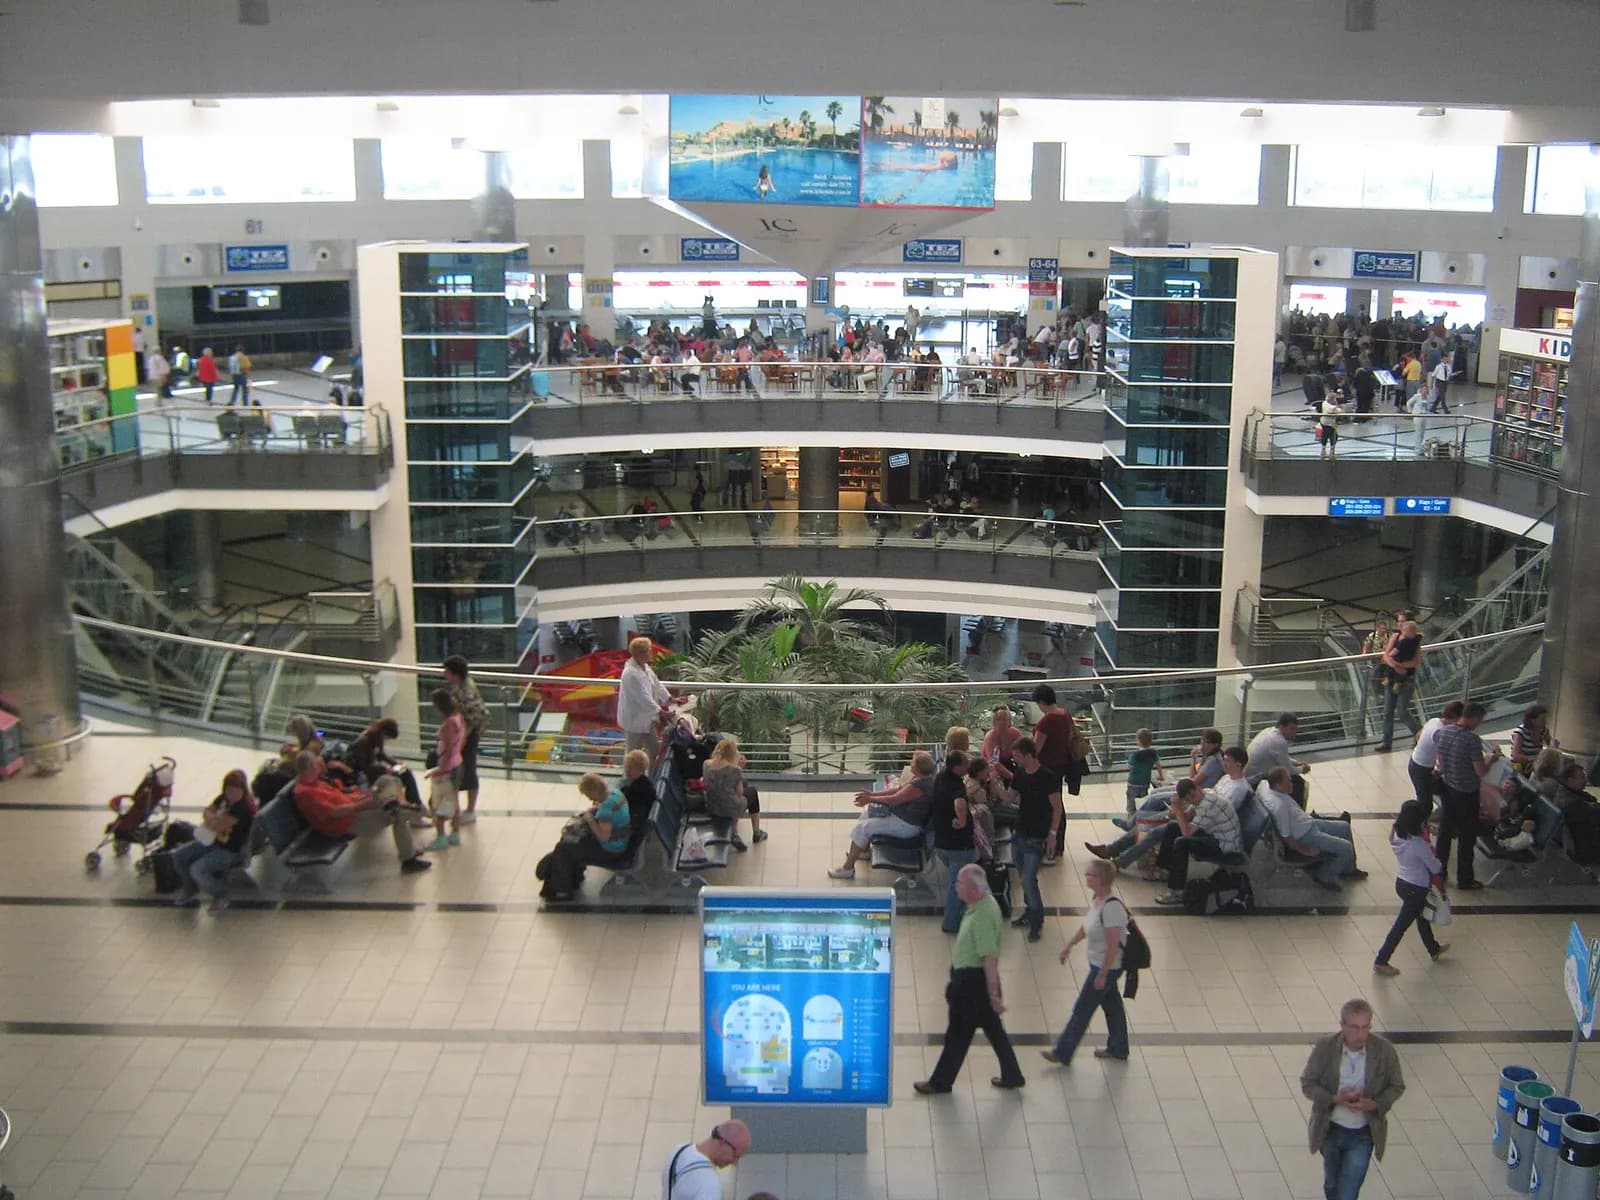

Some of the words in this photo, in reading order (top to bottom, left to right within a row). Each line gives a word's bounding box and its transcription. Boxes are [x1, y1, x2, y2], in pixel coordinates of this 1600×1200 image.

[1030, 259, 1057, 269] 63-64
[1377, 257, 1413, 266] TEZ
[731, 984, 746, 993] YOU
